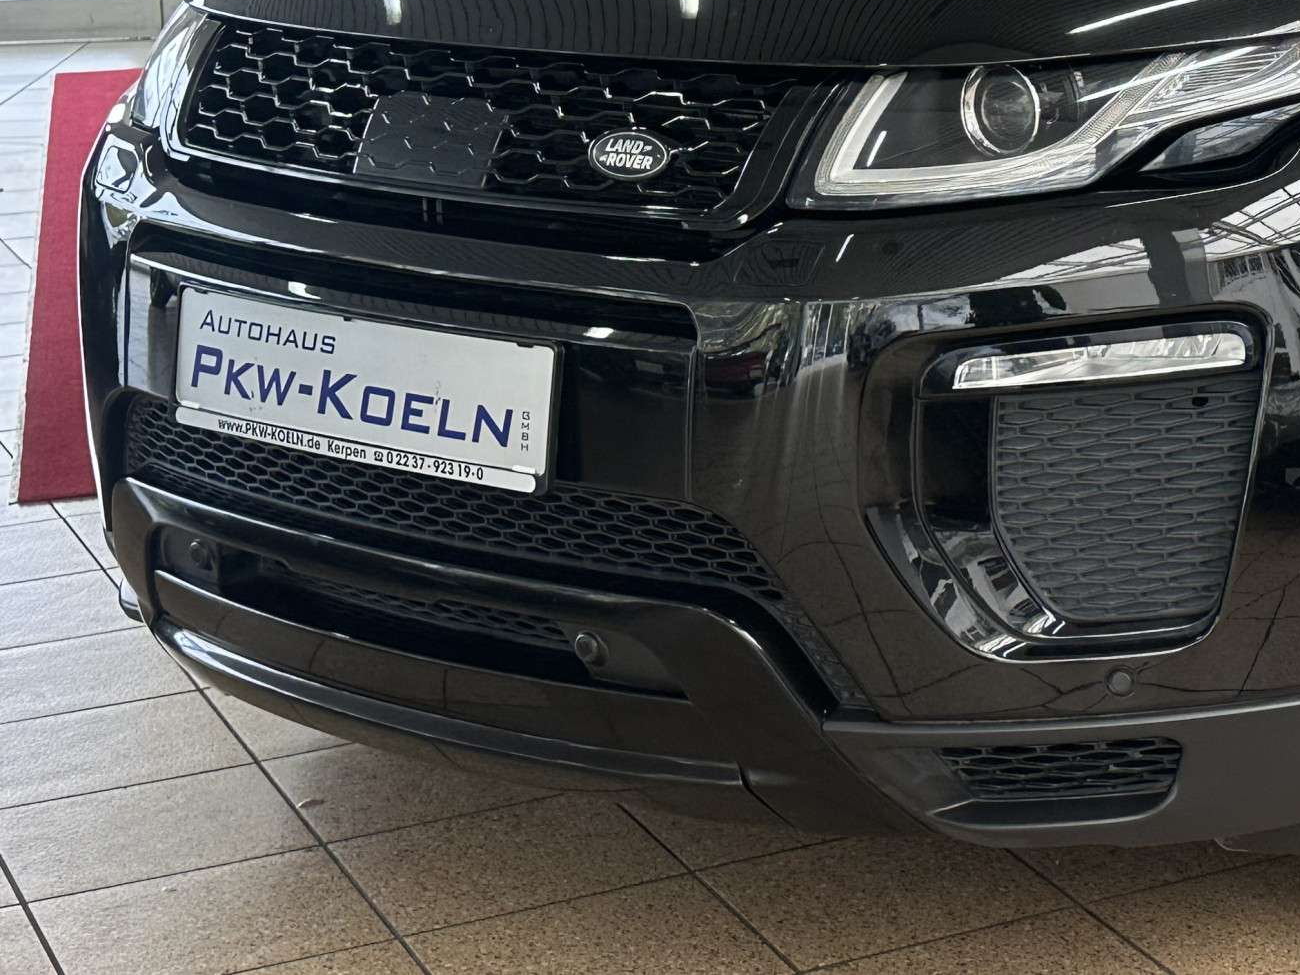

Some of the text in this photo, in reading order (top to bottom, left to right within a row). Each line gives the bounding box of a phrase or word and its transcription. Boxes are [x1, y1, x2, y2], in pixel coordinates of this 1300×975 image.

[605, 138, 644, 153] LAND
[606, 153, 653, 169] ROVER
[199, 309, 336, 355] AUTOHAUS
[190, 344, 514, 448] PKW-KOELN
[217, 418, 321, 450] www.PKW-KOELN.de
[327, 439, 367, 460] Kerpen
